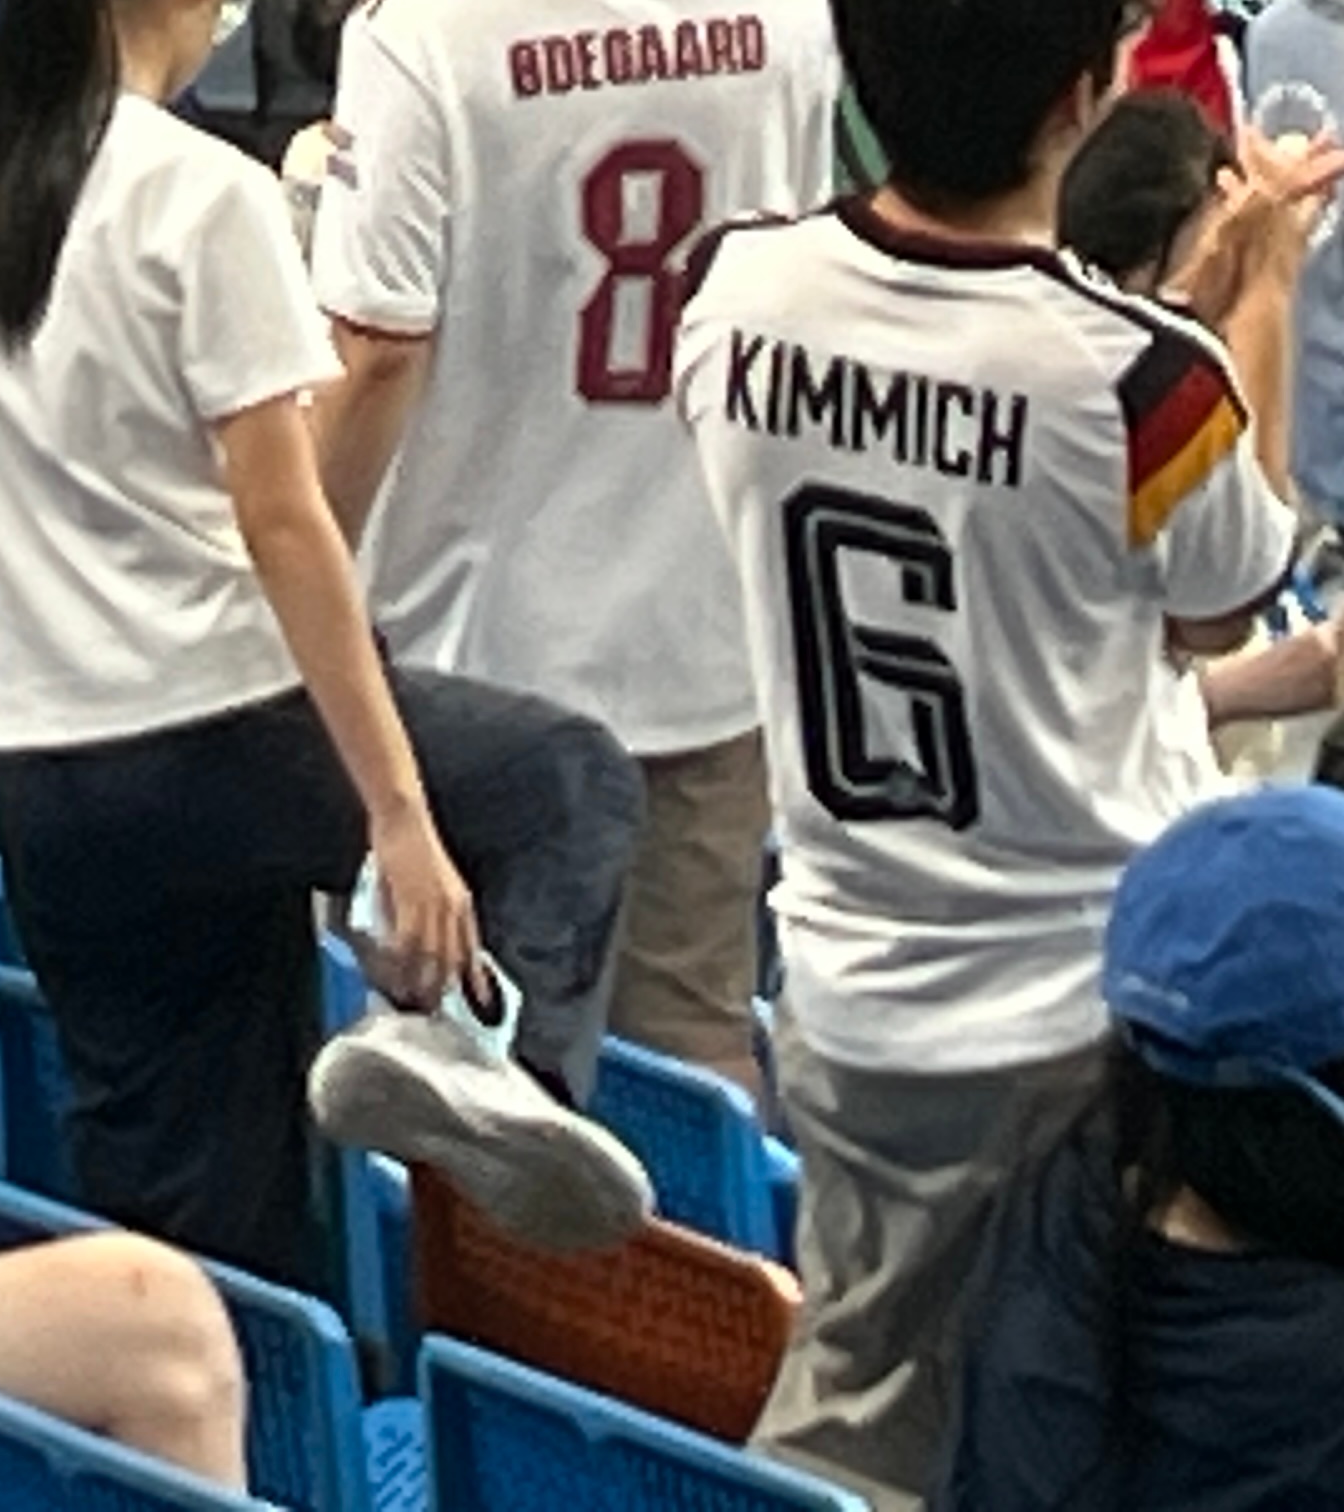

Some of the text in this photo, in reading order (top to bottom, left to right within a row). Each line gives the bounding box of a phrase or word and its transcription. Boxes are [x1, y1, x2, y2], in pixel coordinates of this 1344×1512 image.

[576, 140, 703, 402] 8
[726, 326, 1027, 487] KIMMICH
[783, 481, 982, 831] 6
